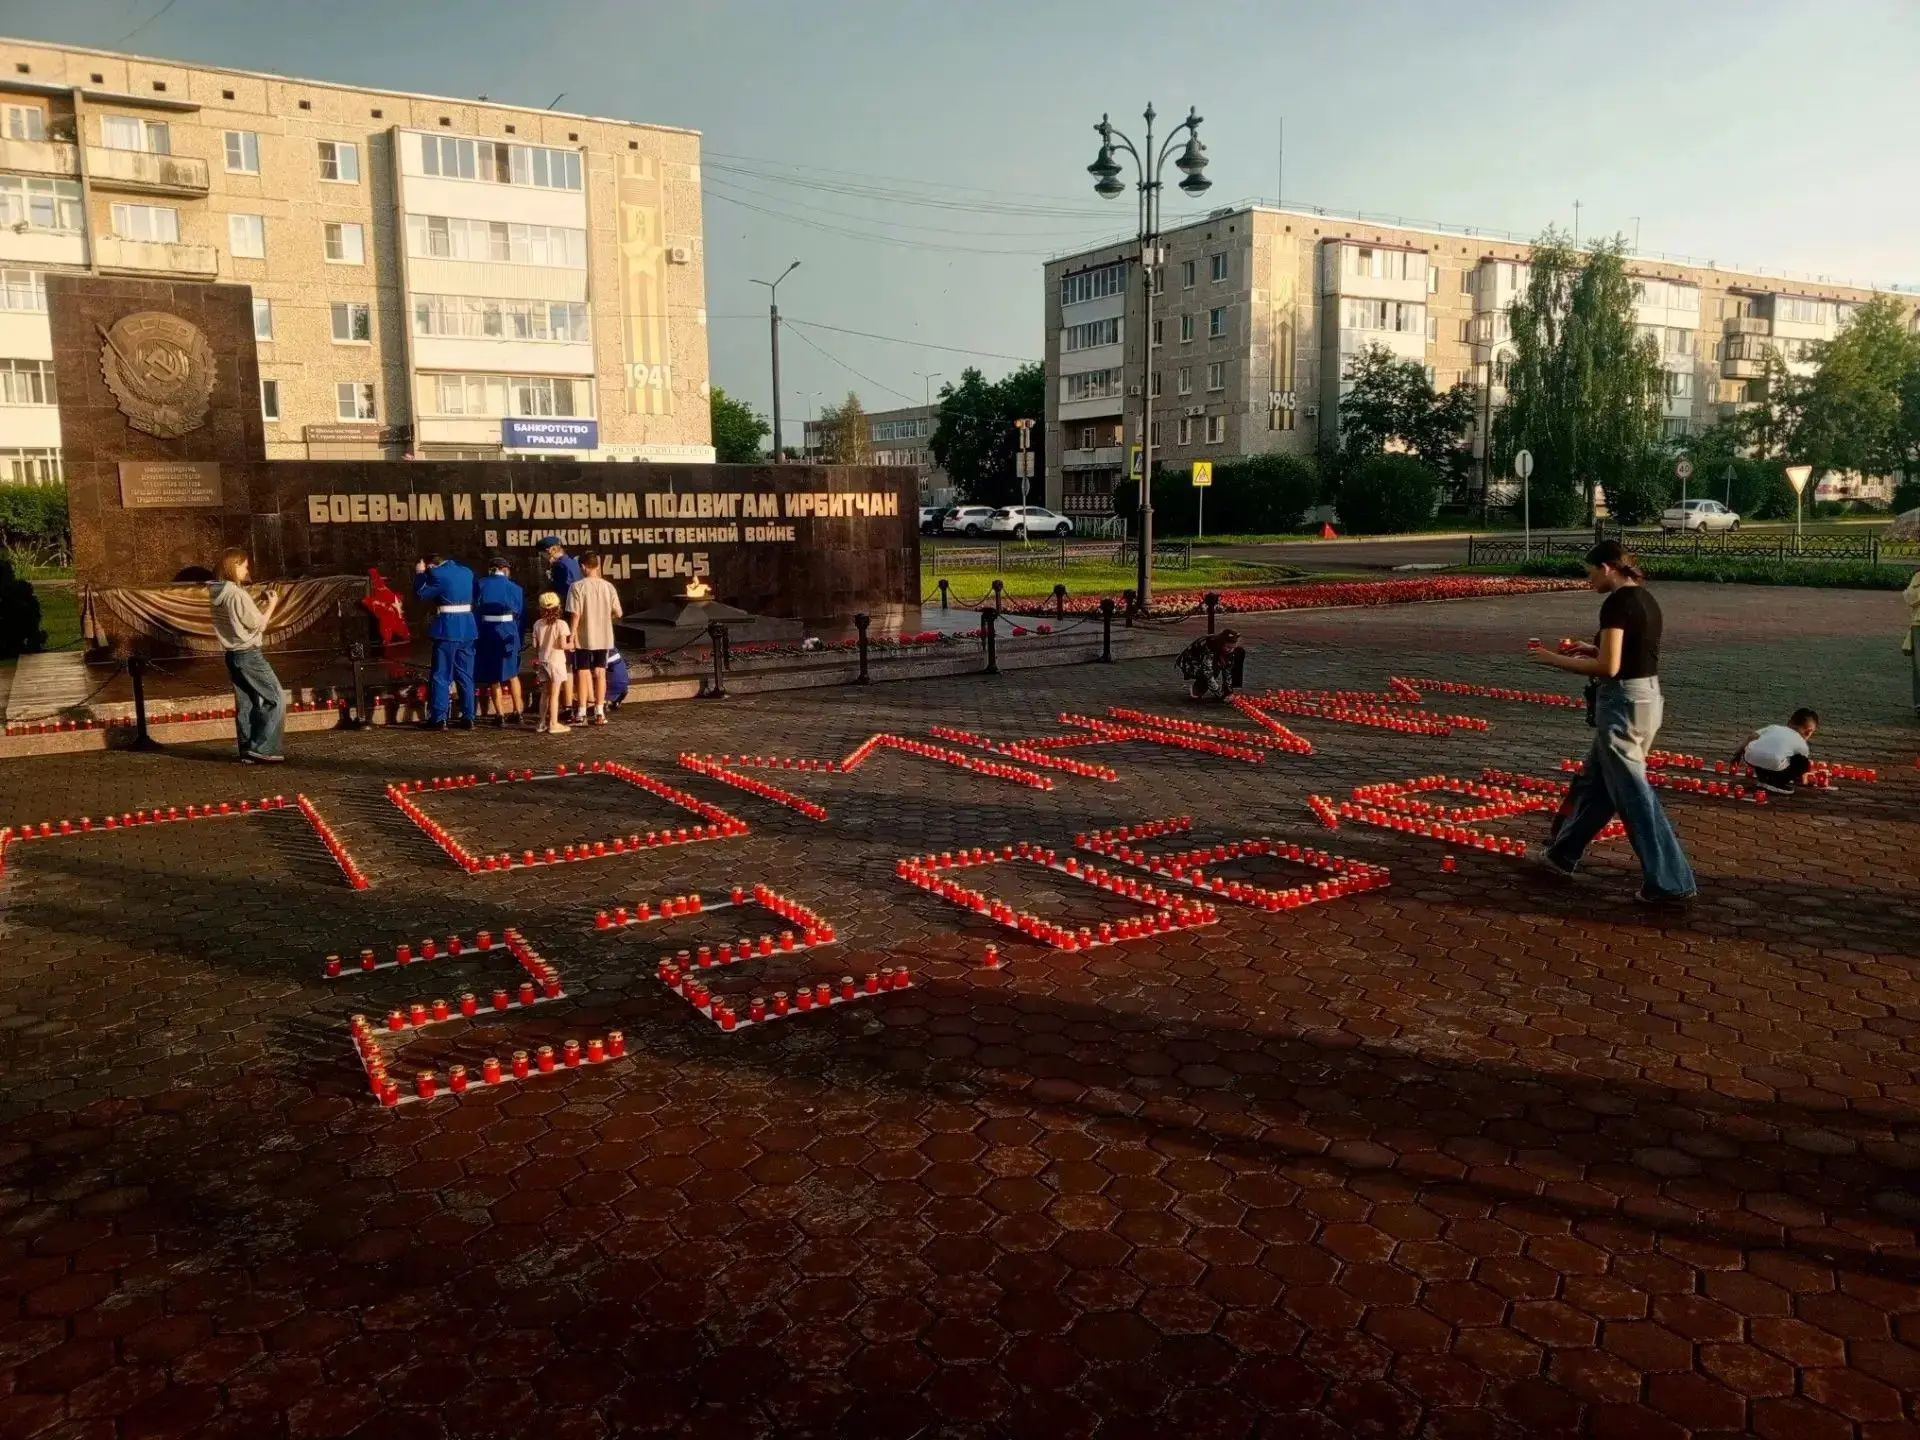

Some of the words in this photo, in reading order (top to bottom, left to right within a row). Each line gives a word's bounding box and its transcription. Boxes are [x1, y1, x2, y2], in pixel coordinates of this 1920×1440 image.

[120, 318, 190, 337] СССР
[624, 364, 672, 388] 1941
[1269, 391, 1296, 409] 1945
[513, 423, 589, 435] БАНКРОТСТВО
[525, 435, 577, 446] ГРАЖДАН
[1679, 465, 1690, 474] 40
[308, 494, 445, 523] БОЕВЫМ
[452, 493, 473, 520] И
[481, 492, 639, 520] ТРУДОВЫМ
[645, 493, 779, 518] ПОДВИГАМ
[785, 493, 898, 517] ИРБИТЧАН
[485, 530, 498, 547] В
[599, 522, 739, 545] ОТЕЧЕСТВЕННОЙ
[745, 521, 796, 542] ВОЙНЕ
[577, 552, 710, 580] 41–1945
